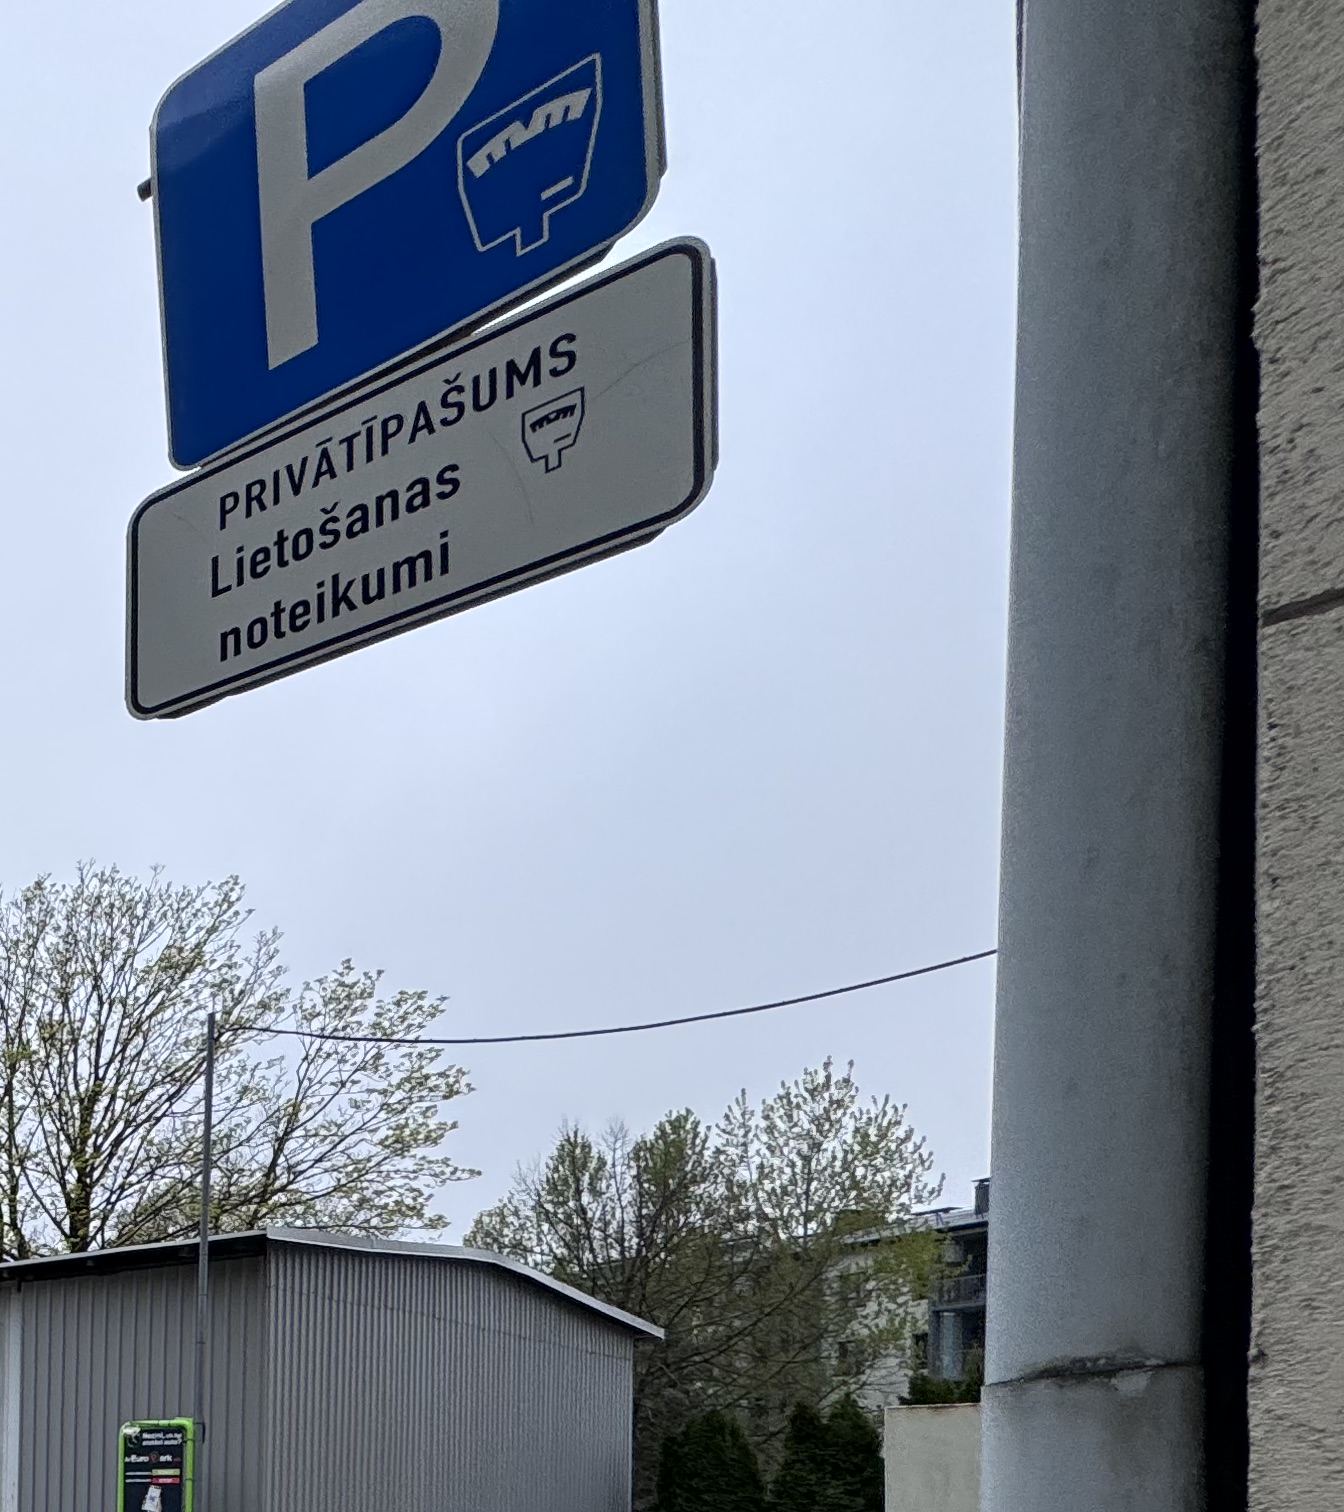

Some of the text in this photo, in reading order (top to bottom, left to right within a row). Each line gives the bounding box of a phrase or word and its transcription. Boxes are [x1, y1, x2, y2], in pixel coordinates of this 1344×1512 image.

[254, 0, 499, 371] P
[219, 332, 577, 531] PRIVĀTĪPAŠUMS
[211, 463, 460, 598] Lietošanas
[220, 530, 450, 662] noteikumi
